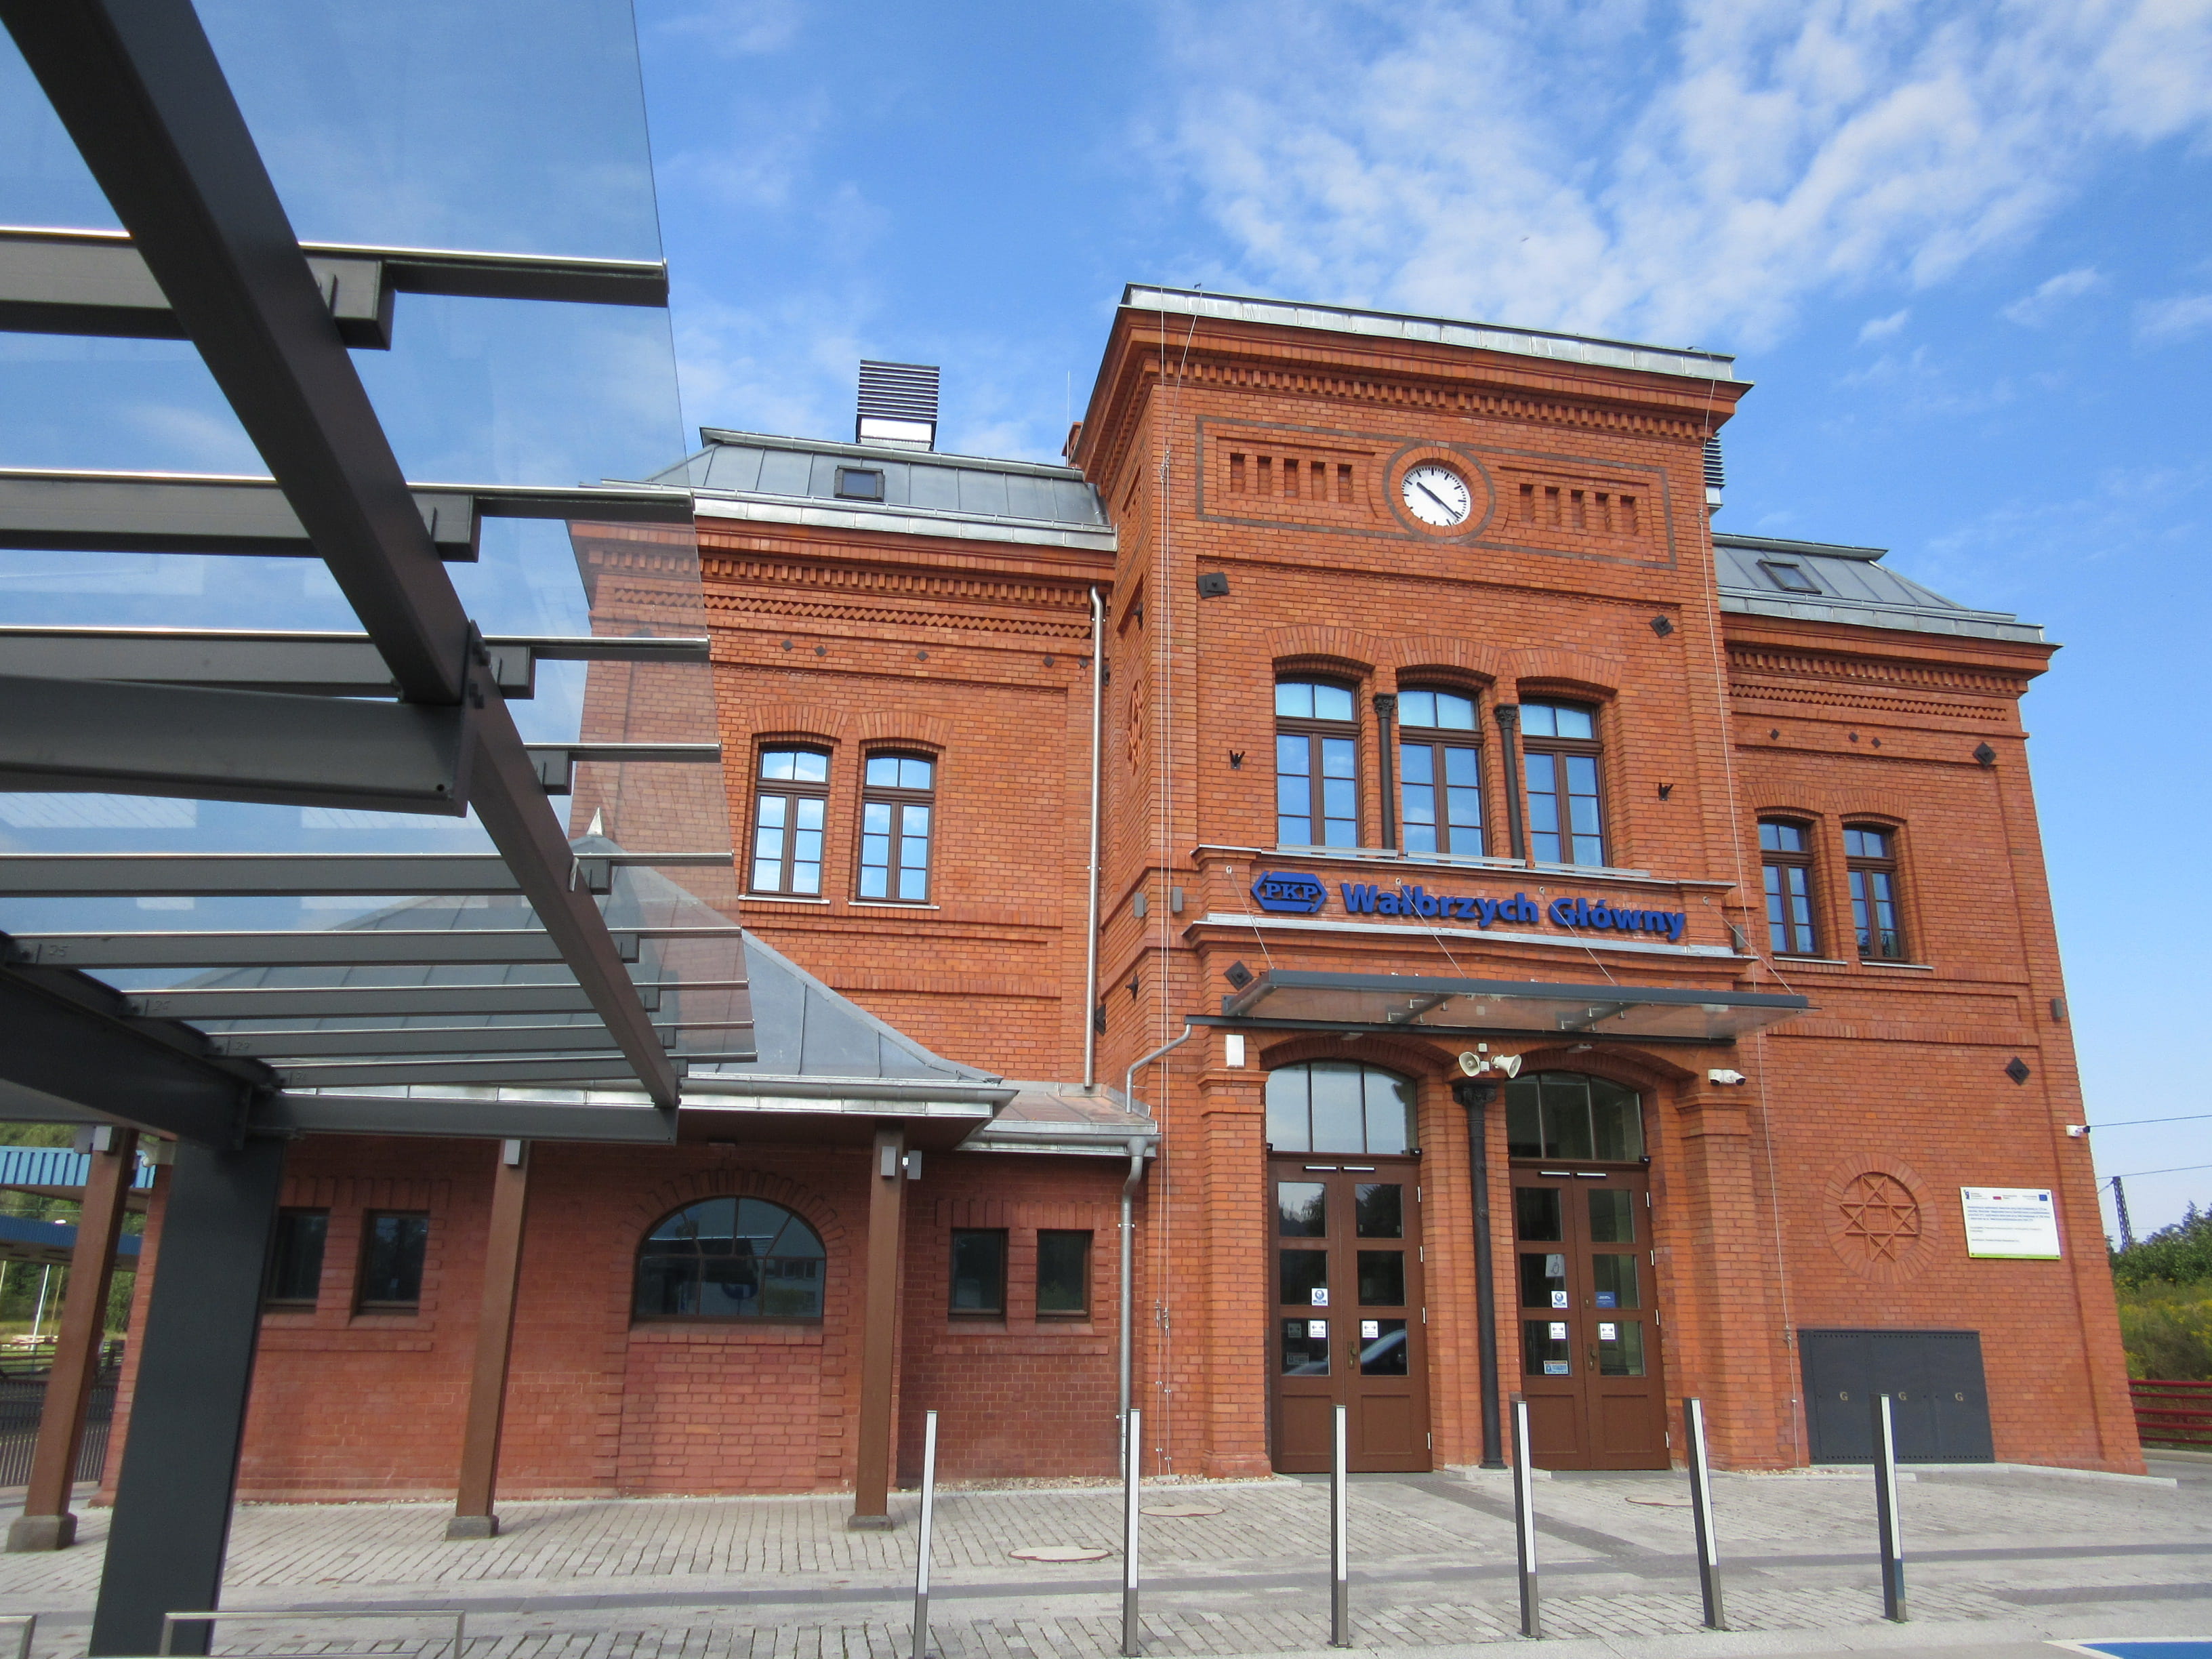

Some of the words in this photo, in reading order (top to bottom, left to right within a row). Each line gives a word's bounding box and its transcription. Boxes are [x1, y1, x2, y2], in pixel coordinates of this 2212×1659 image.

[1264, 882, 1318, 901] PKP
[1340, 882, 1539, 928] Wałbrzych
[1549, 897, 1685, 941] Główny
[1839, 1391, 1849, 1401] G
[1898, 1391, 1907, 1401] G
[1954, 1392, 1964, 1401] G
